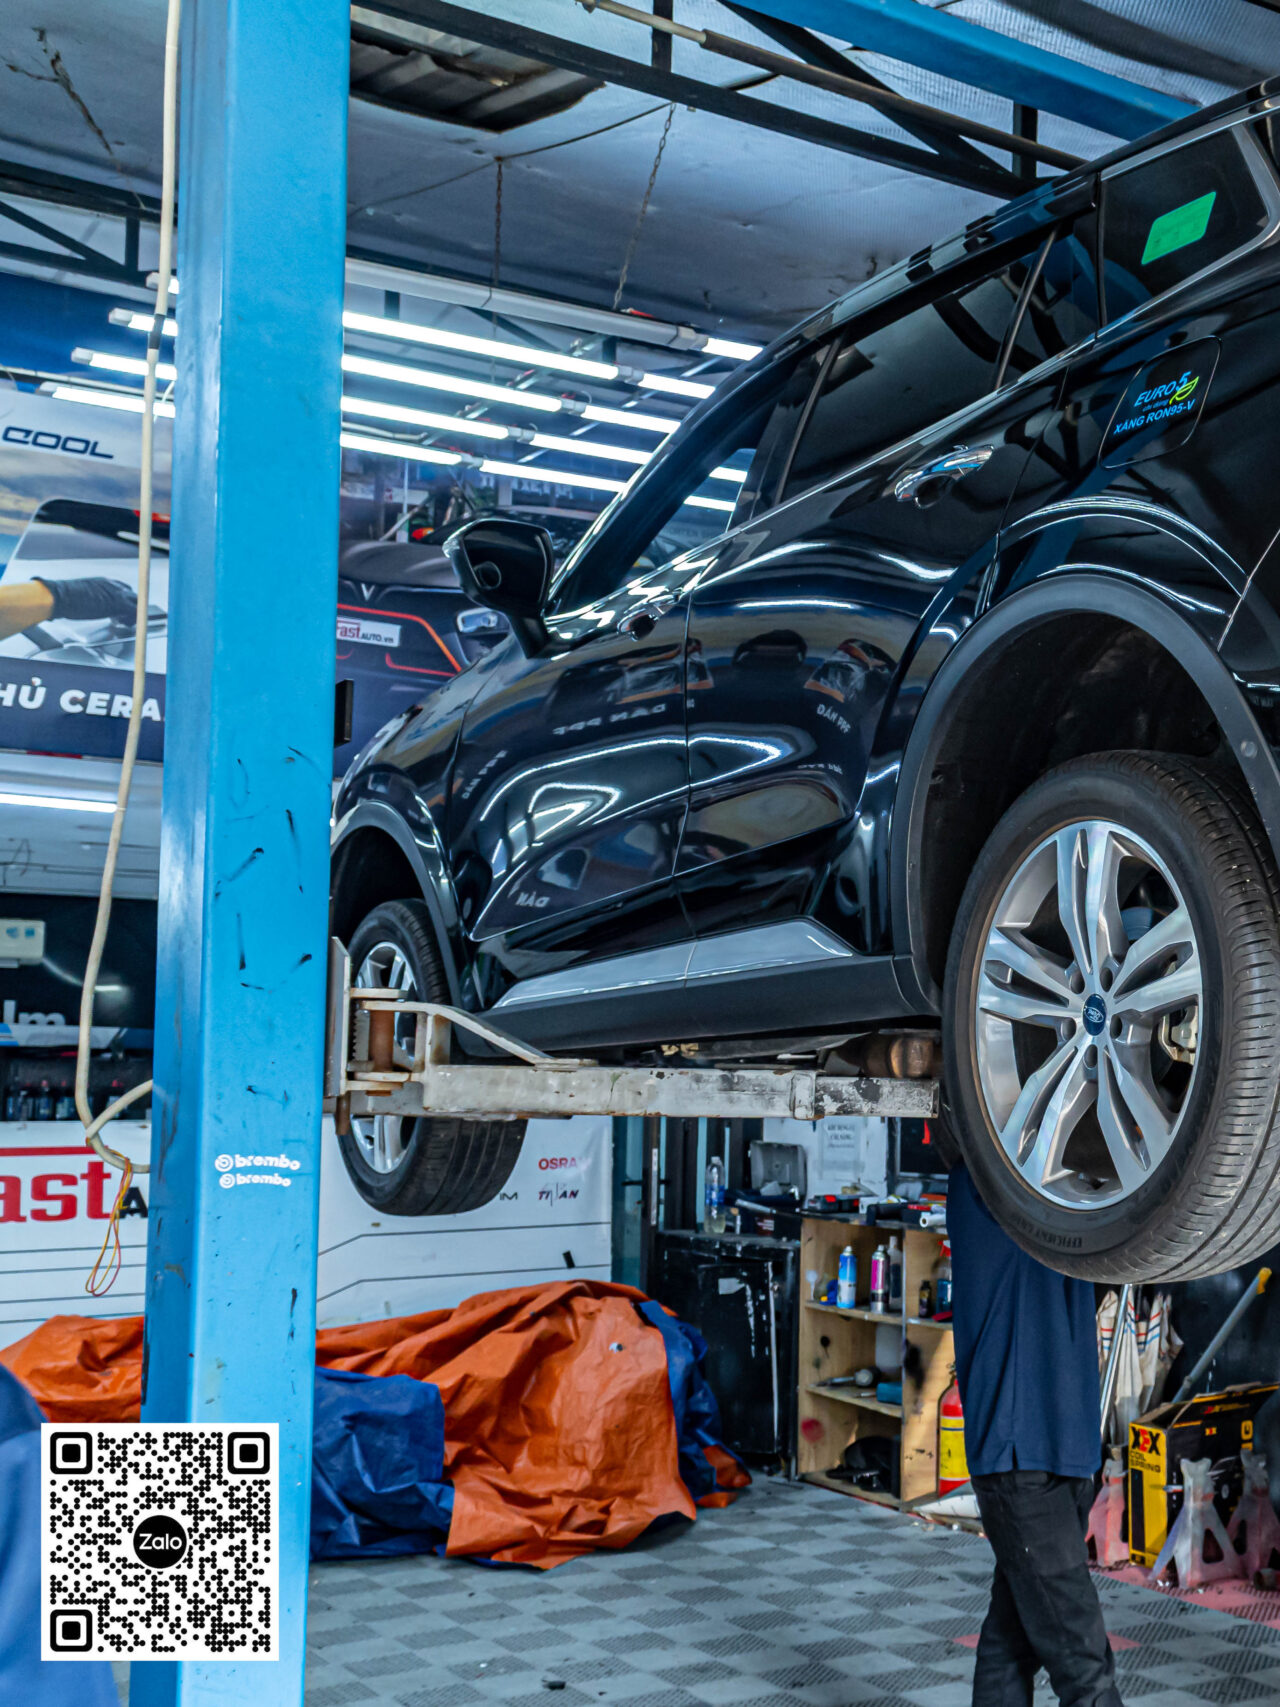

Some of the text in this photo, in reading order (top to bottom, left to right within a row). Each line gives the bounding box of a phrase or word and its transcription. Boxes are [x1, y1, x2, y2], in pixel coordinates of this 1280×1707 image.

[1134, 381, 1176, 407] EURO
[2, 426, 114, 460] COOL
[59, 689, 162, 722] CERA
[235, 1154, 301, 1170] brembo
[538, 1156, 579, 1172] OSRA
[236, 1174, 291, 1187] brembo
[1131, 1426, 1161, 1457] XEX
